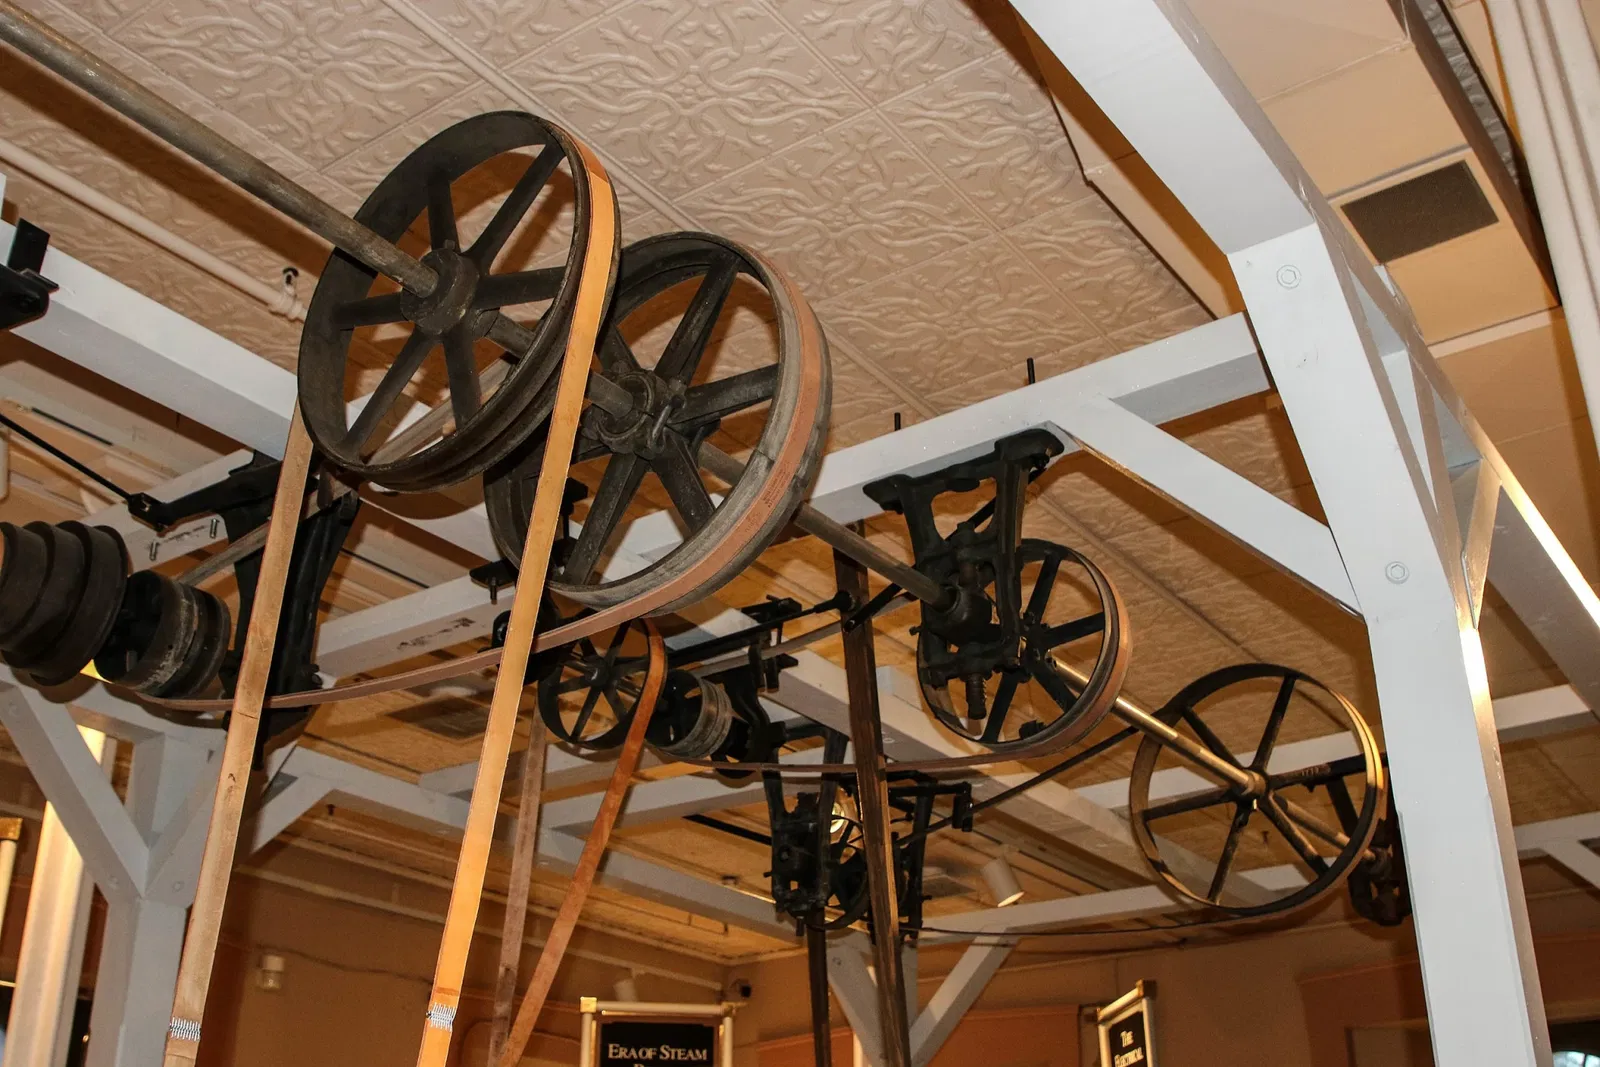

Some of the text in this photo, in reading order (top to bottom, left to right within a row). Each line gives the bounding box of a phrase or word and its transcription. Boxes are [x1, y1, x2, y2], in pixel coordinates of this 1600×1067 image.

[1120, 1031, 1134, 1047] THE
[608, 1043, 708, 1061] ERA OF STEAM
